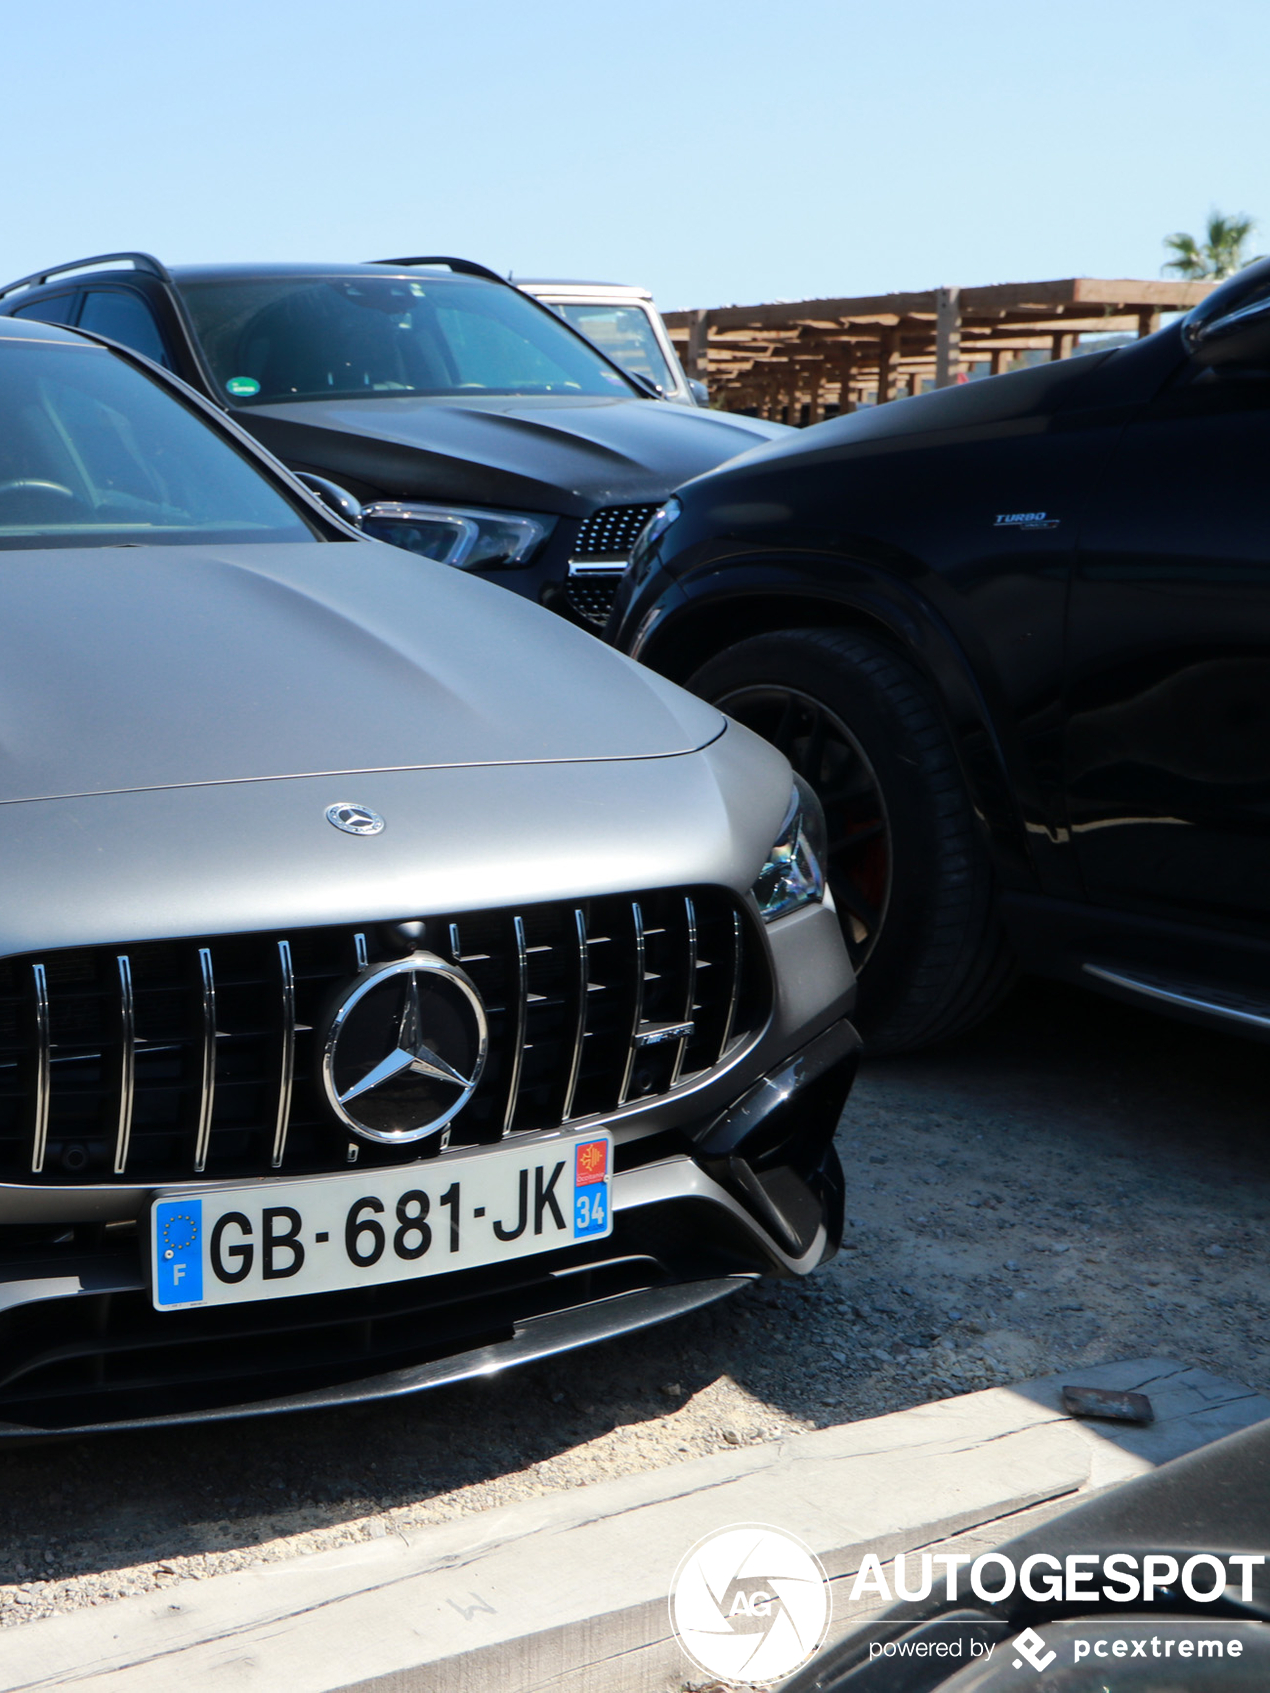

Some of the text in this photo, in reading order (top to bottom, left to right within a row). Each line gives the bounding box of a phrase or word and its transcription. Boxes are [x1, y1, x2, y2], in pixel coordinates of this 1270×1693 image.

[996, 512, 1046, 522] TURBO
[210, 1161, 567, 1283] GB-681-JK
[576, 1192, 605, 1228] 34
[172, 1264, 187, 1286] F
